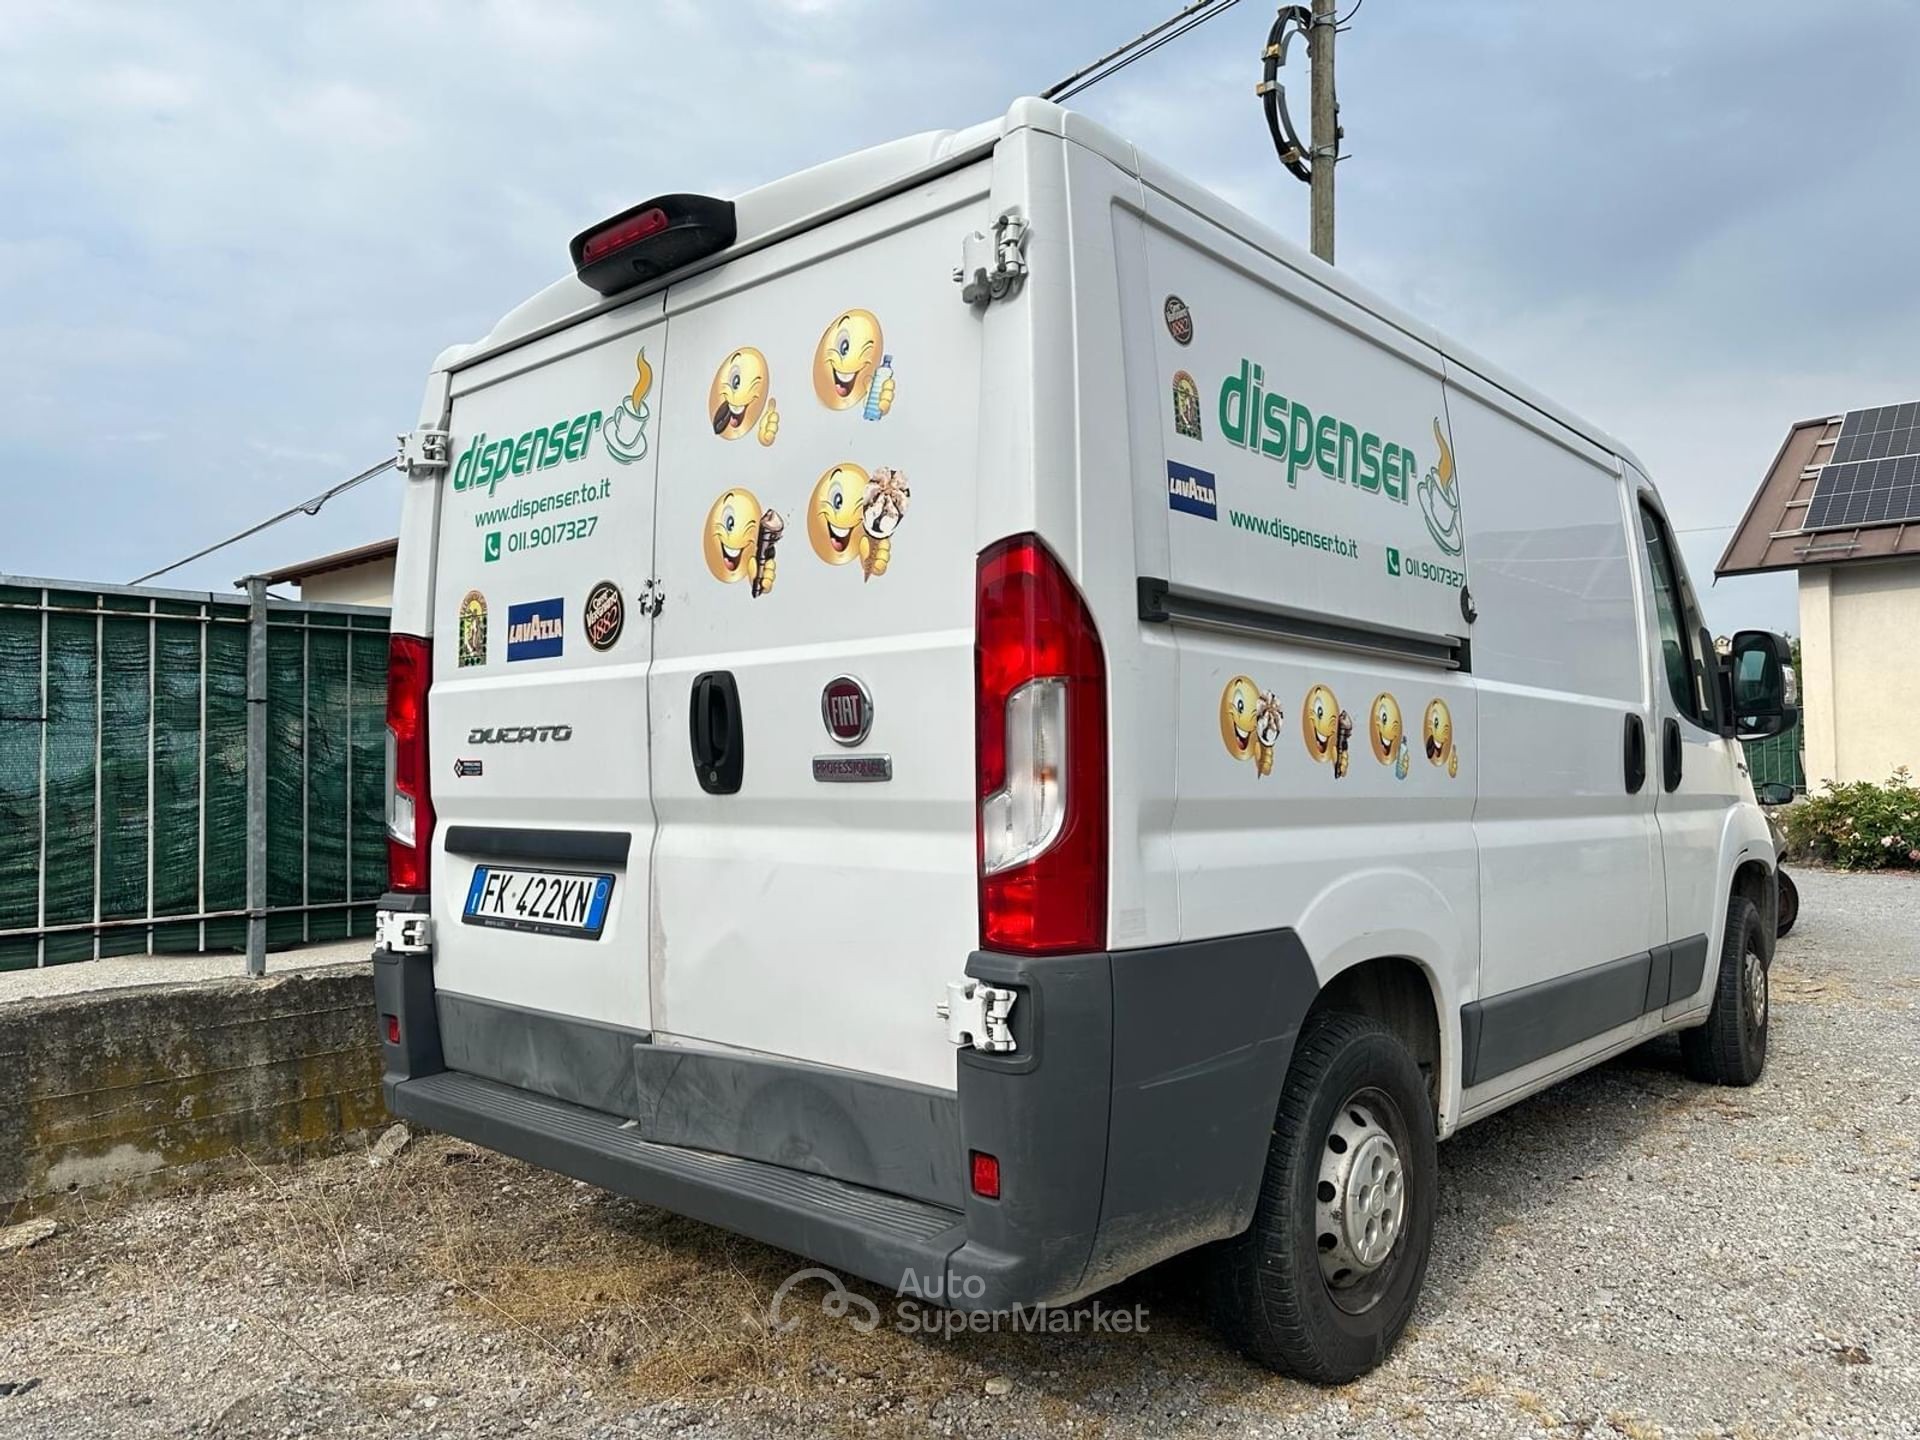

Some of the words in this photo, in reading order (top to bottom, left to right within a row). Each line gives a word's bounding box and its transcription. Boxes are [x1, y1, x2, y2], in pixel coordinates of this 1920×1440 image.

[1219, 358, 1417, 505] dispenser
[453, 411, 602, 495] dispenser
[475, 478, 611, 528] www.dispenser.to.it
[1170, 477, 1216, 505] LAVAZZA
[508, 516, 598, 552] 011.9017327
[1229, 509, 1358, 559] www.dispenser.to.it
[1405, 557, 1464, 588] 011.9017327
[509, 614, 562, 643] LAVAZZA
[592, 606, 618, 644] 1882
[831, 694, 859, 726] FIAT
[468, 725, 573, 744] DUCATO
